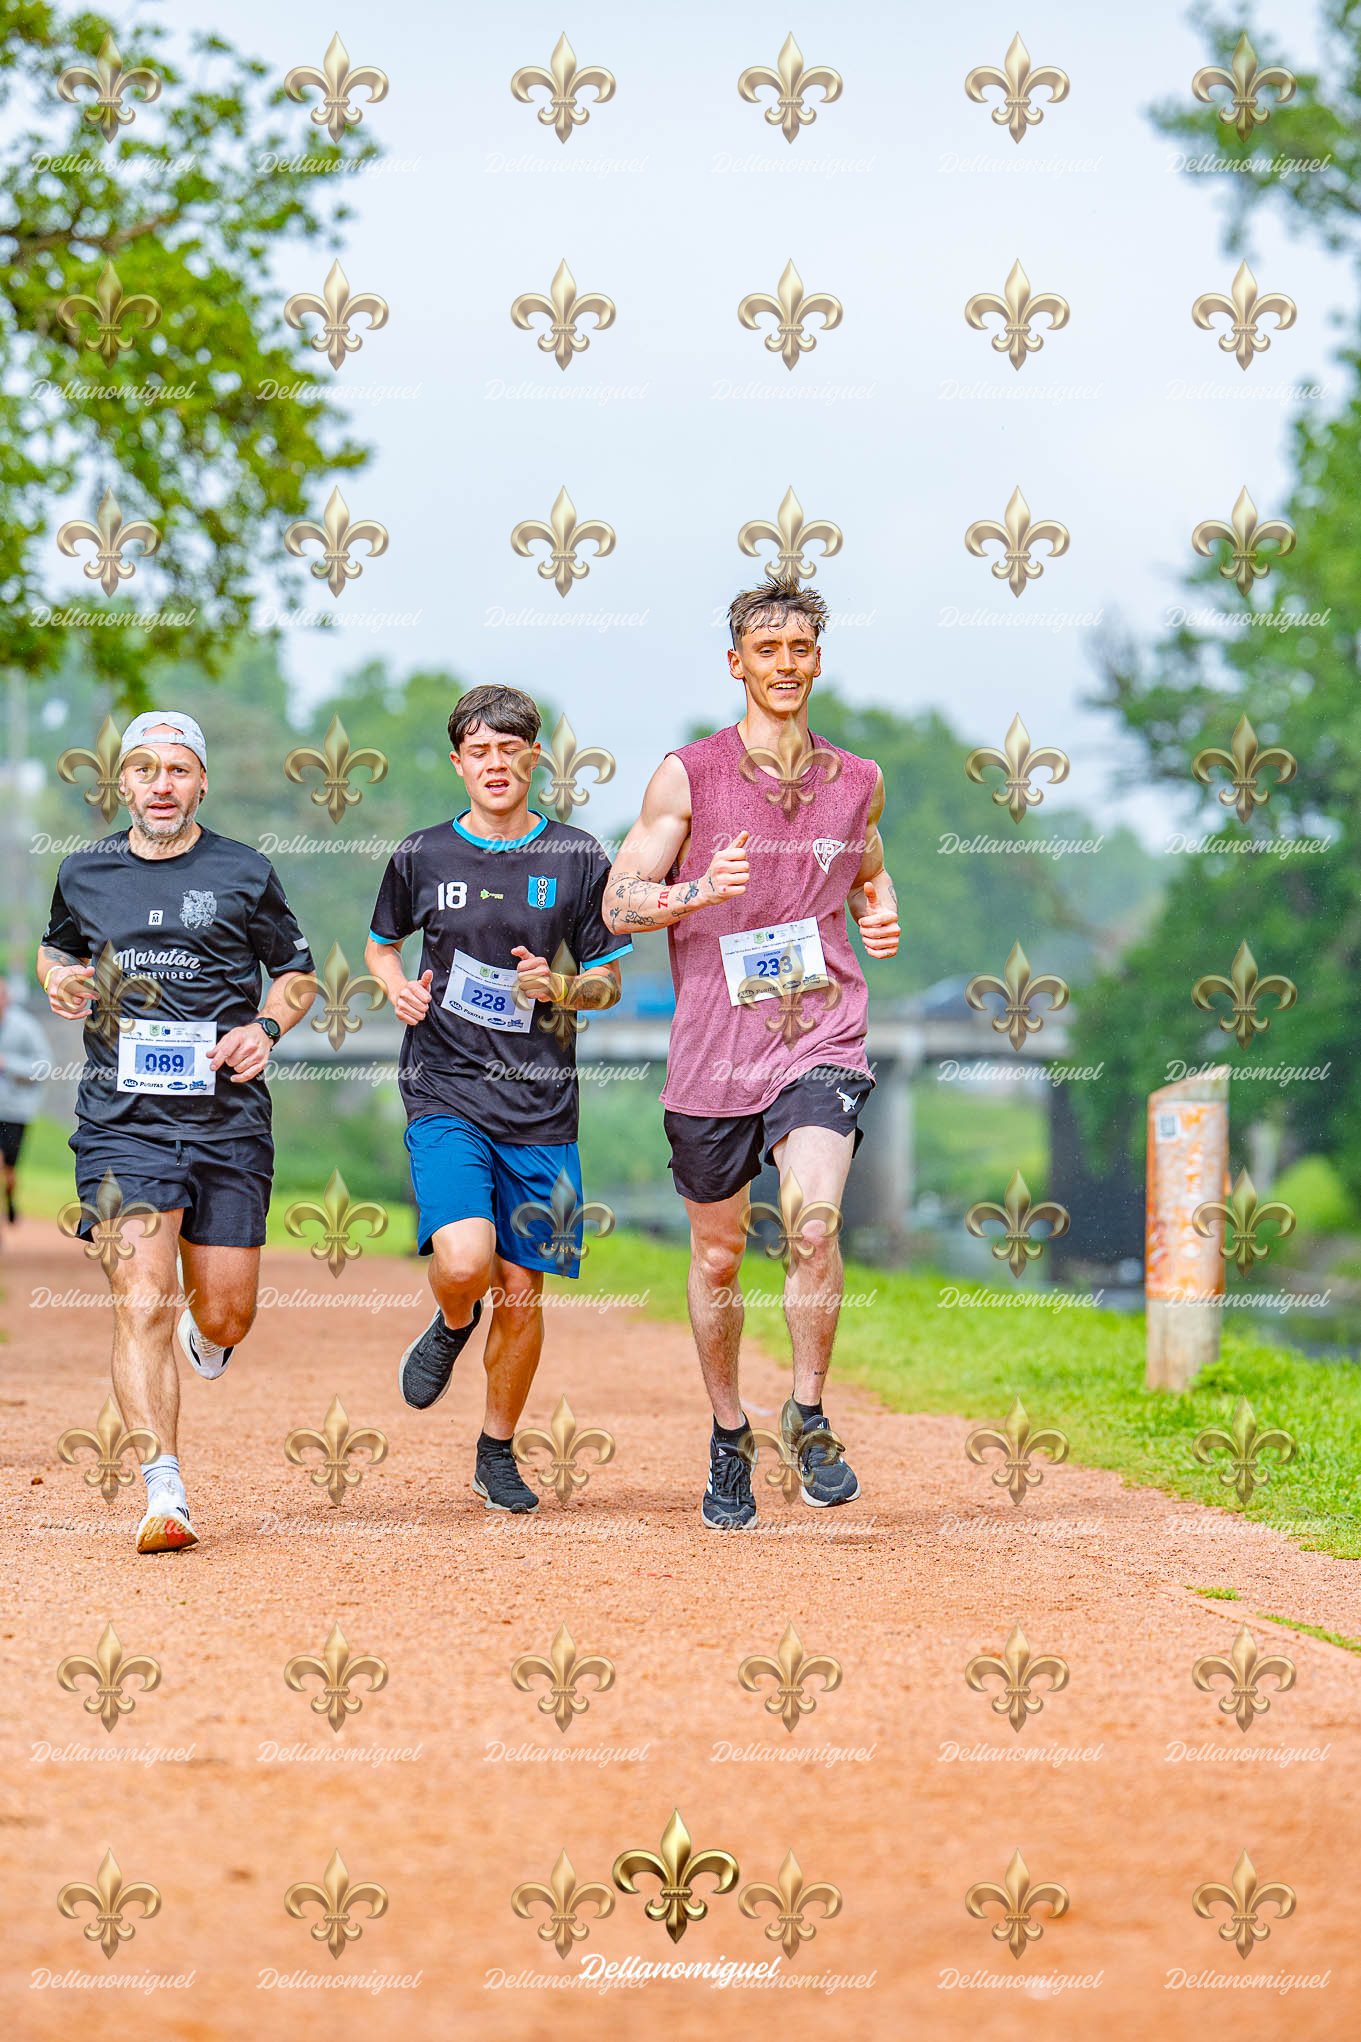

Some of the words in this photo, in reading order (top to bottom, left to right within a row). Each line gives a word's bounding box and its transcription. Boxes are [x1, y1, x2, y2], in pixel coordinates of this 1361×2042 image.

[437, 881, 468, 911] 18
[112, 948, 201, 970] Maratón
[757, 955, 793, 978] 233
[126, 972, 194, 980] ONTEVIDEO
[470, 989, 506, 1012] 228
[145, 1053, 184, 1073] 089
